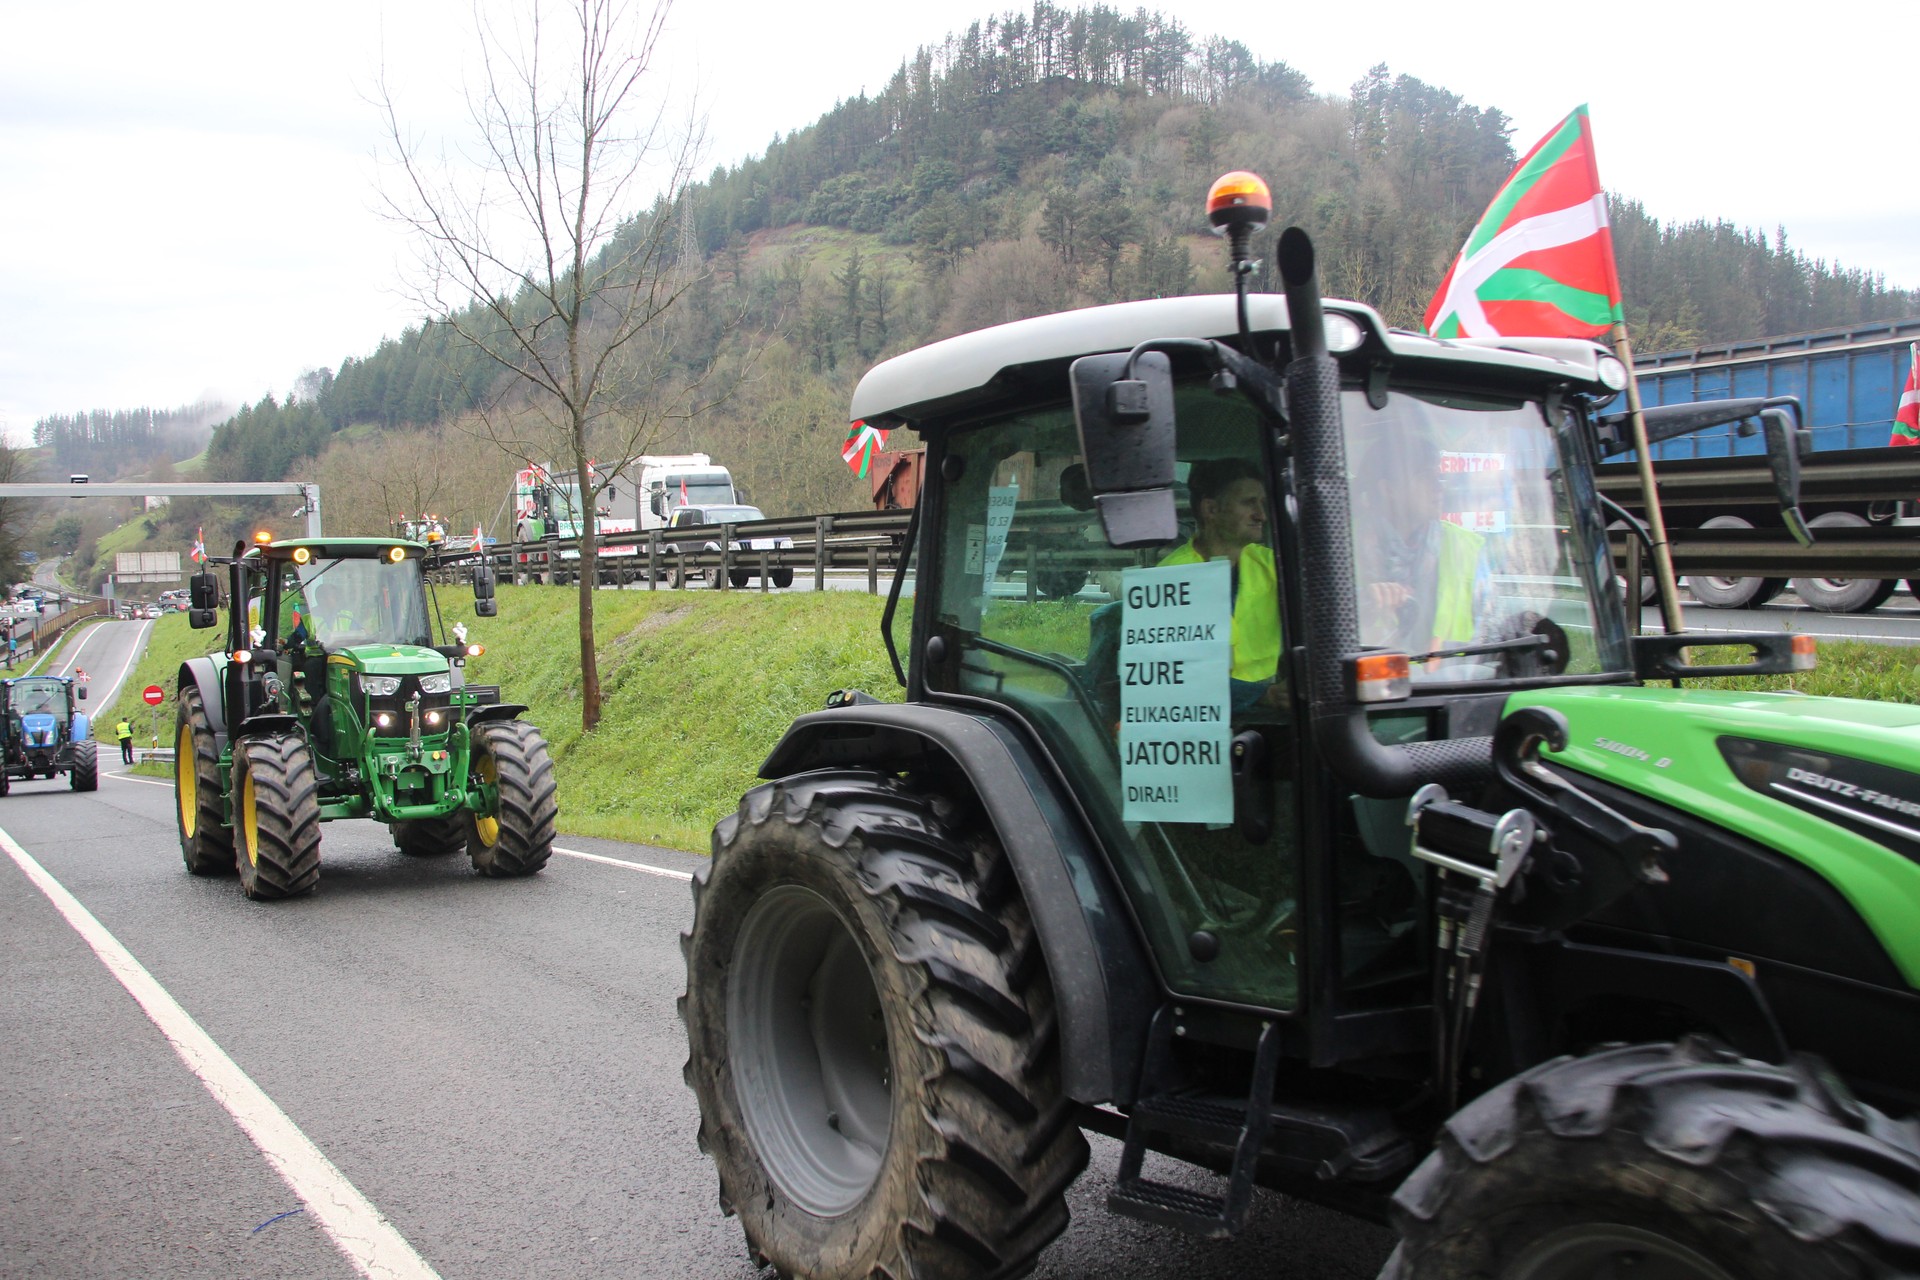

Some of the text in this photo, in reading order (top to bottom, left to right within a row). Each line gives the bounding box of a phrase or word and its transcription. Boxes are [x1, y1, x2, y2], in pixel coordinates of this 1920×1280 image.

[1127, 581, 1191, 610] GURE
[1126, 623, 1216, 645] BASERRIAK
[1125, 660, 1184, 686] ZURE
[1125, 705, 1221, 723] ELIKAGAIEN
[1125, 740, 1221, 766] JATORRI
[1127, 785, 1179, 803] DIRA!!
